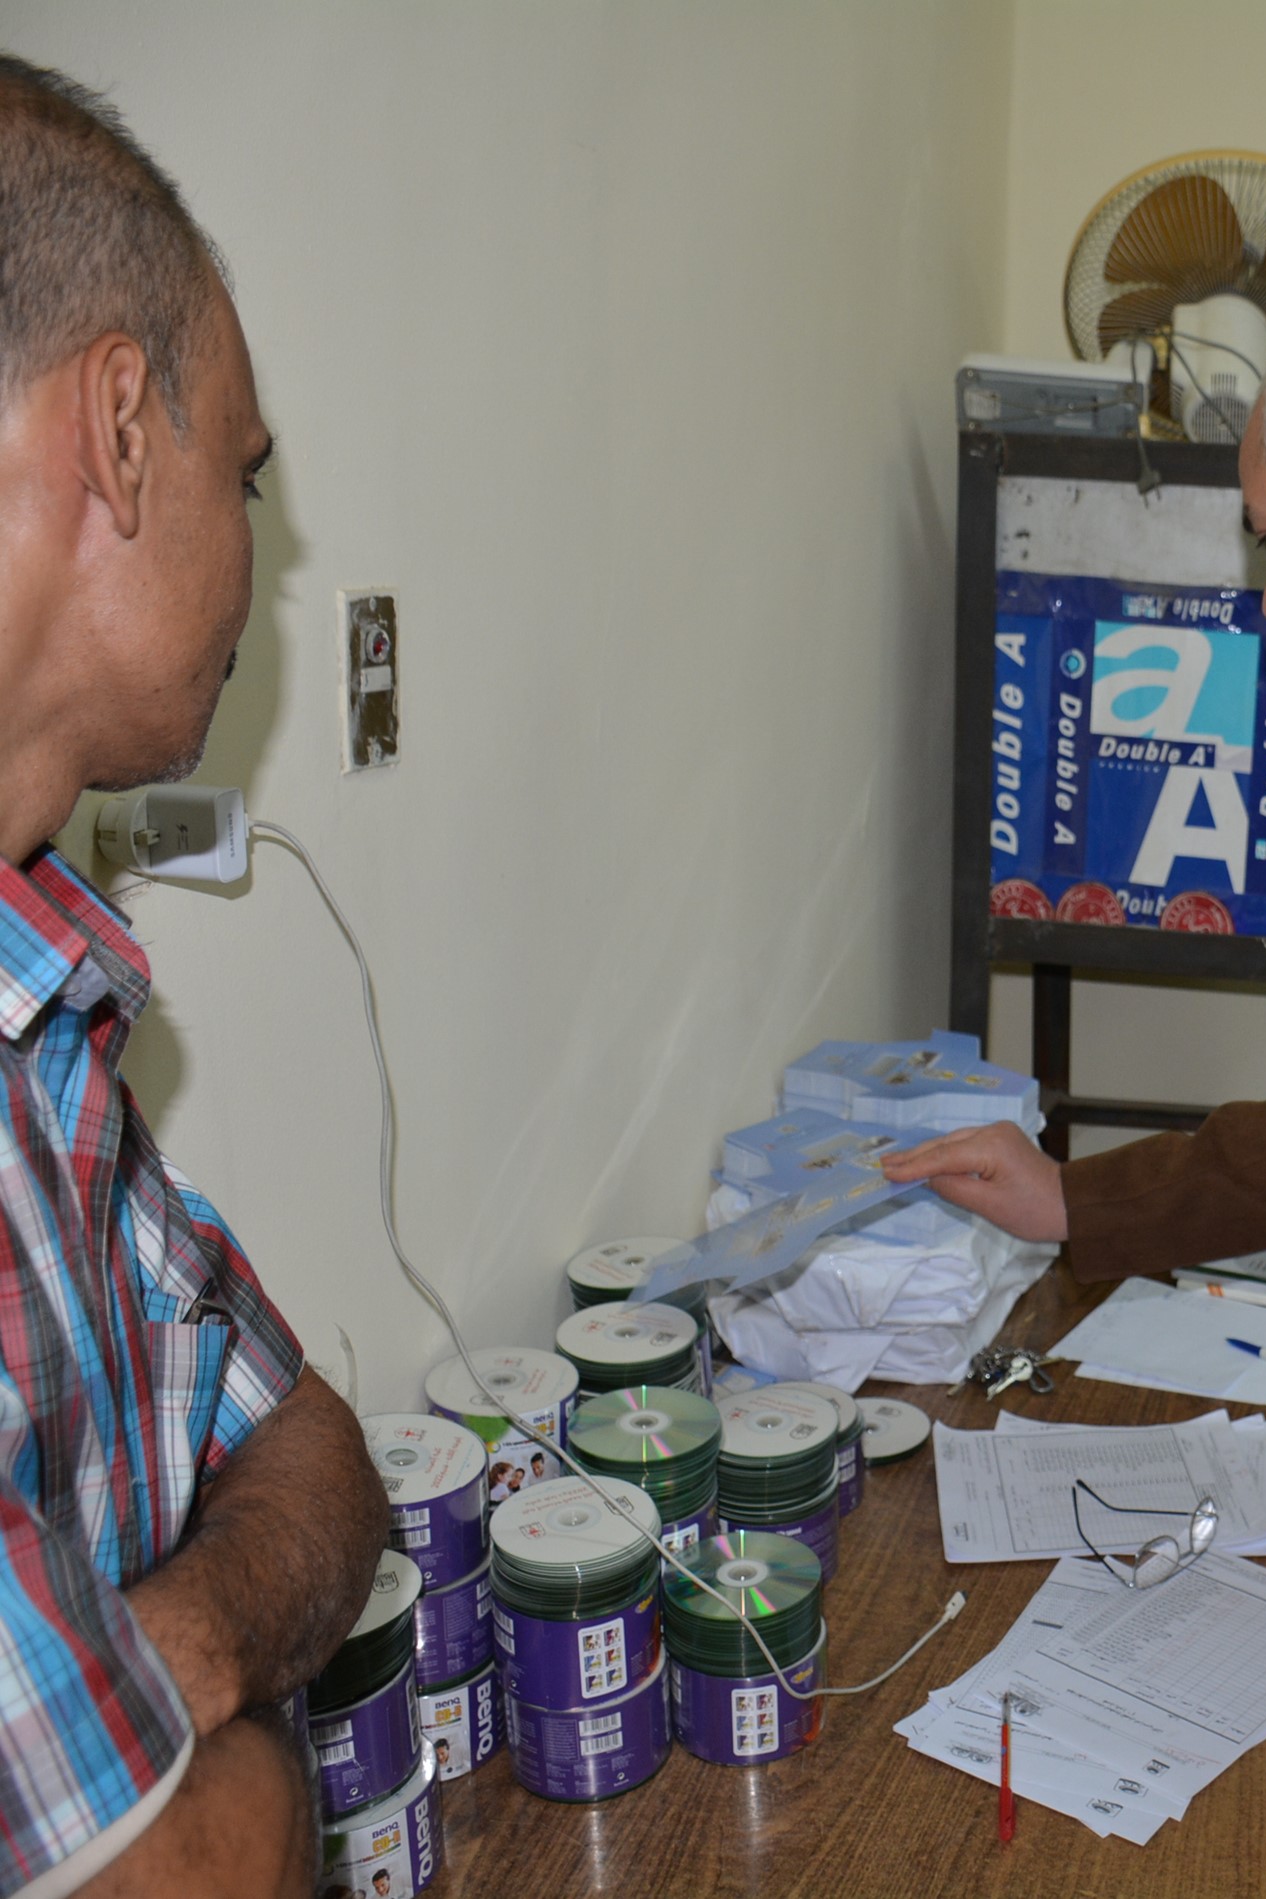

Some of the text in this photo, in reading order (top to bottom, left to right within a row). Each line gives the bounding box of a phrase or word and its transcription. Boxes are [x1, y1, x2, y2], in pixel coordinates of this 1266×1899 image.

[1154, 597, 1173, 620] A
[1172, 600, 1235, 624] Double
[995, 633, 1027, 667] A
[991, 683, 1025, 856] Double
[1053, 693, 1084, 846] Double A
[1098, 739, 1182, 764] Double
[227, 812, 236, 858] SAMSUNG
[1129, 765, 1250, 896] A
[476, 1679, 495, 1761] BenQ
[371, 1821, 399, 1839] BenQ
[414, 1796, 434, 1886] BenQ
